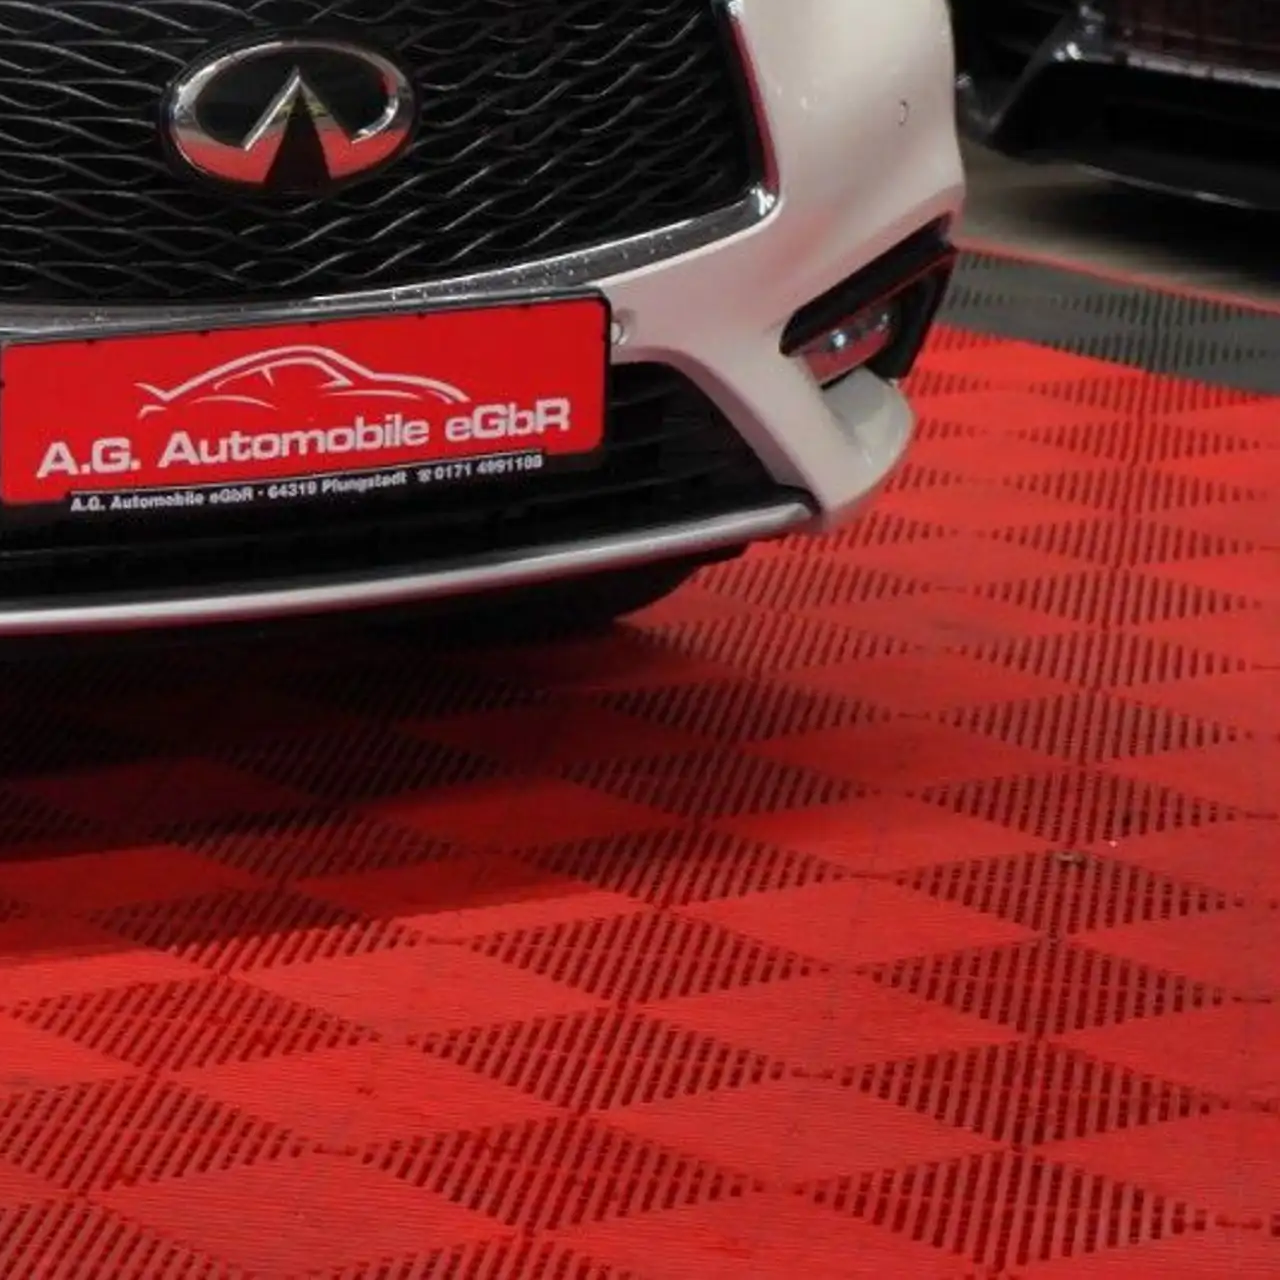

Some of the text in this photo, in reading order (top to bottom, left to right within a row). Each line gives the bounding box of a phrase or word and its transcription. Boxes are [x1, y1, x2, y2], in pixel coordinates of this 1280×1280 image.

[37, 398, 570, 478] A.G. Automobile eGbR
[110, 491, 204, 510] Automobile
[209, 486, 253, 503] eGbR
[267, 481, 317, 499] 64319
[321, 472, 408, 495] Pfungstadt
[434, 463, 471, 480] 0171
